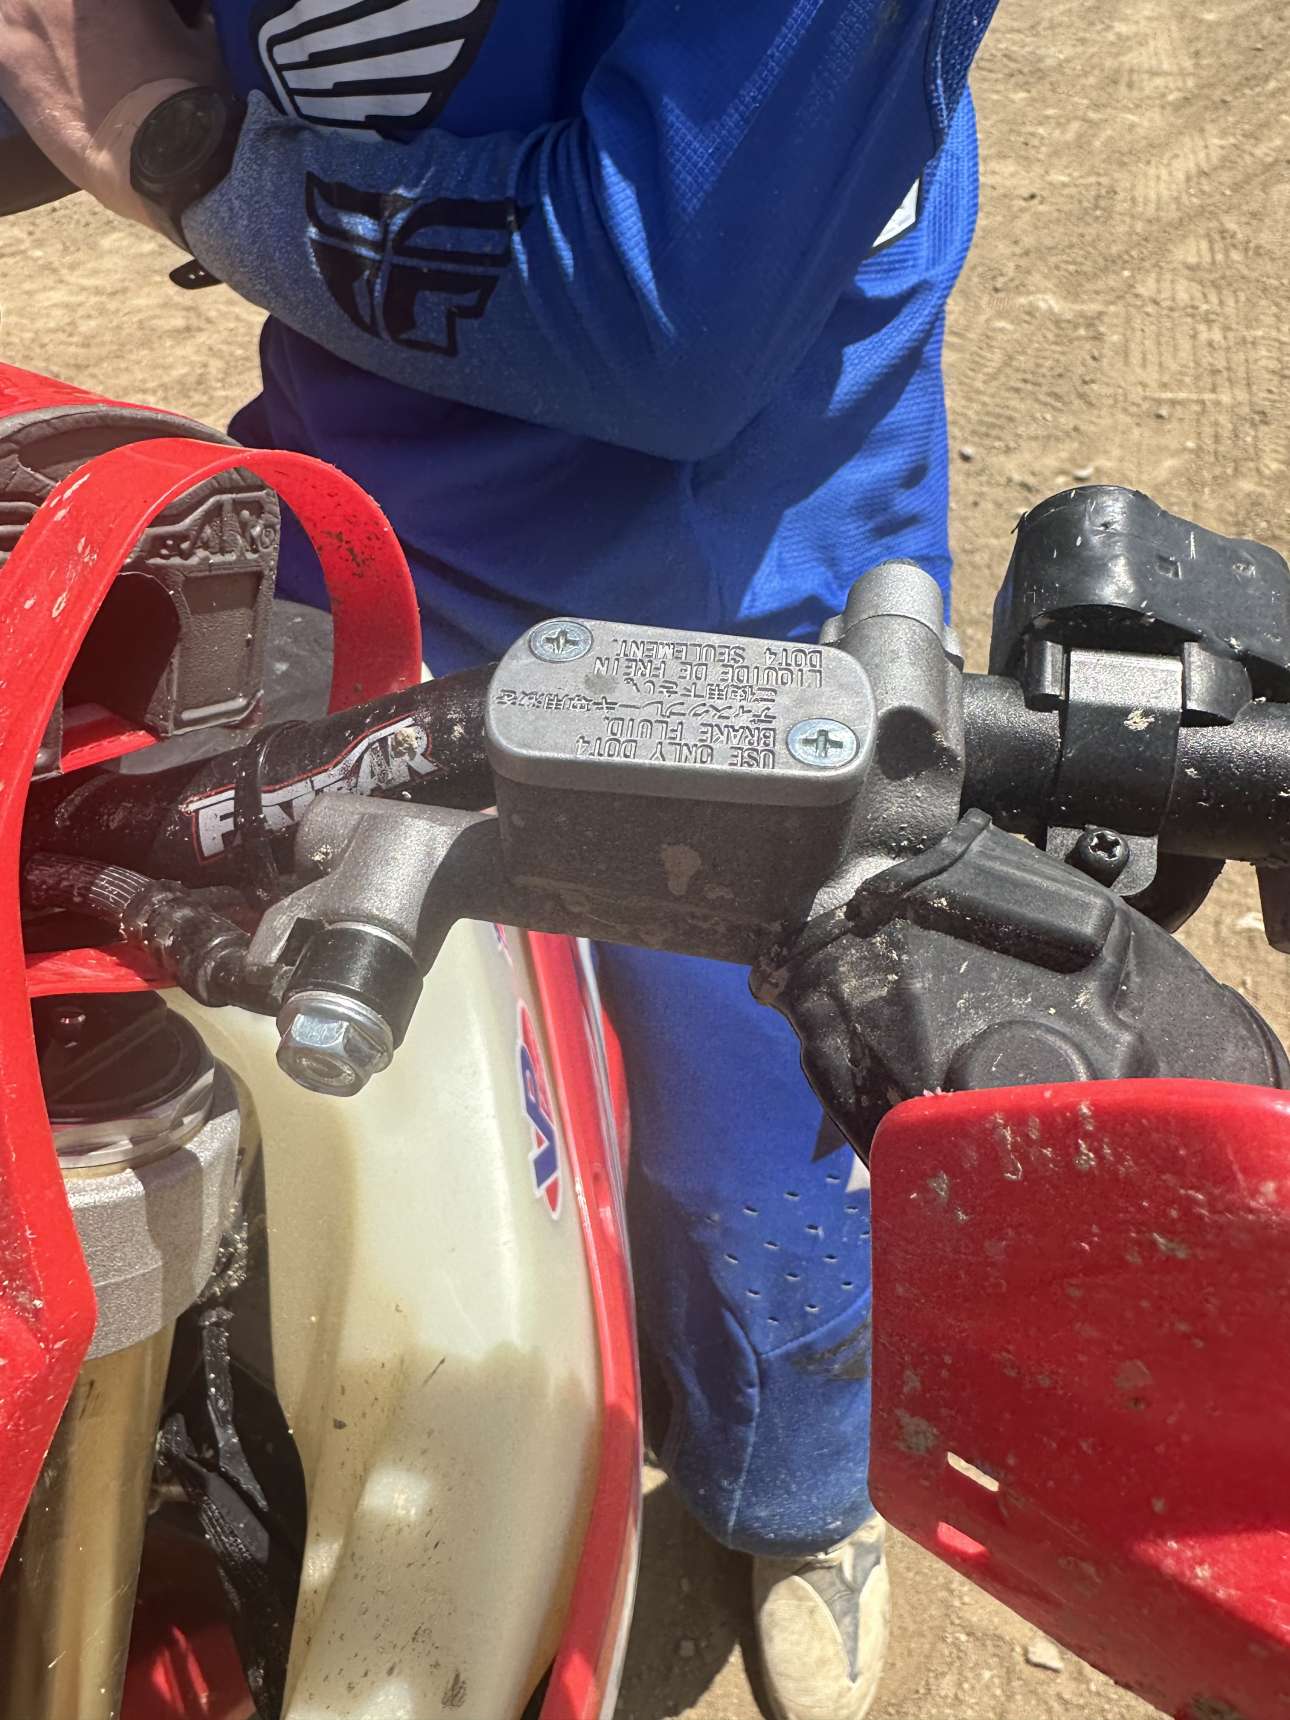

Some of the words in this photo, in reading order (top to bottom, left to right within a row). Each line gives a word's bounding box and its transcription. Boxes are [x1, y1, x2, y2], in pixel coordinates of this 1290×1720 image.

[612, 638, 746, 665] SEULEMENT.
[764, 647, 823, 669] DOT4
[593, 656, 666, 679] FREIN
[678, 661, 708, 681] DE
[719, 663, 823, 688] LIQUIDE
[496, 689, 776, 724] ディスクブレーキ専用液を
[603, 716, 683, 741] FLUID.
[699, 722, 776, 748] BRAKE
[576, 735, 638, 758] DOT4
[650, 741, 714, 764] ONLY
[728, 746, 775, 769] USE
[183, 717, 438, 857] FTAR
